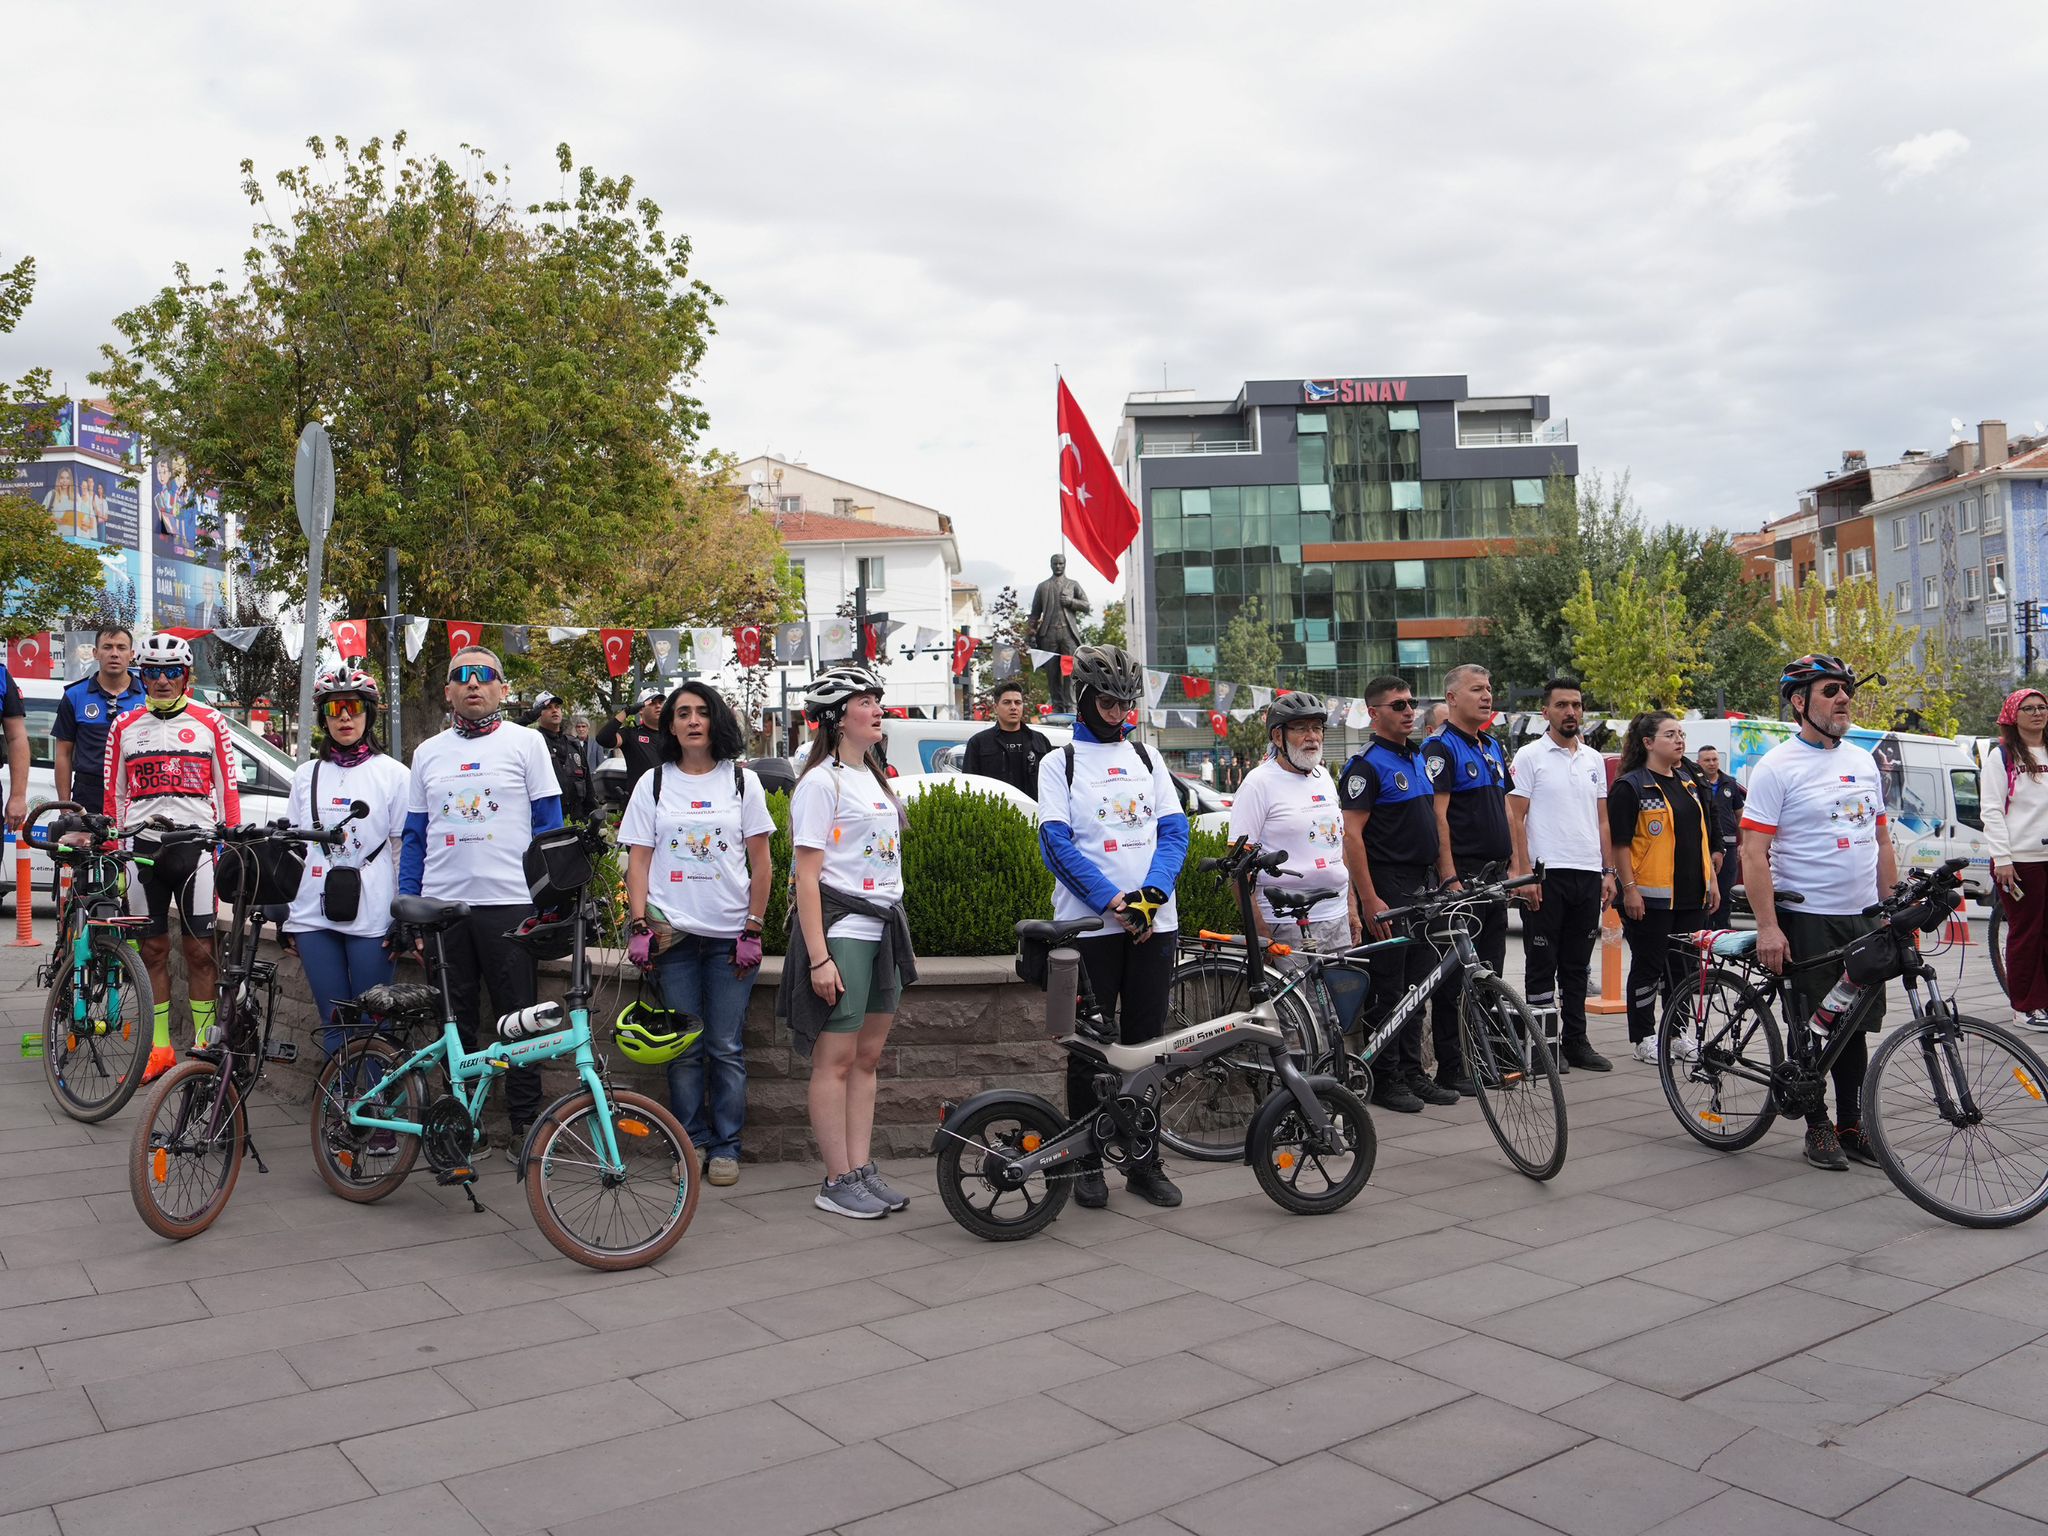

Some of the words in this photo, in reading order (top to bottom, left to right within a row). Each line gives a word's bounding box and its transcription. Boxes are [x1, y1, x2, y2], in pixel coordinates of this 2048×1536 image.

[1340, 379, 1408, 403] SINAV
[156, 577, 173, 597] DAHA
[139, 774, 182, 789] DOSD
[1376, 965, 1443, 1049] MERIDA
[459, 1058, 479, 1070] FLEXI
